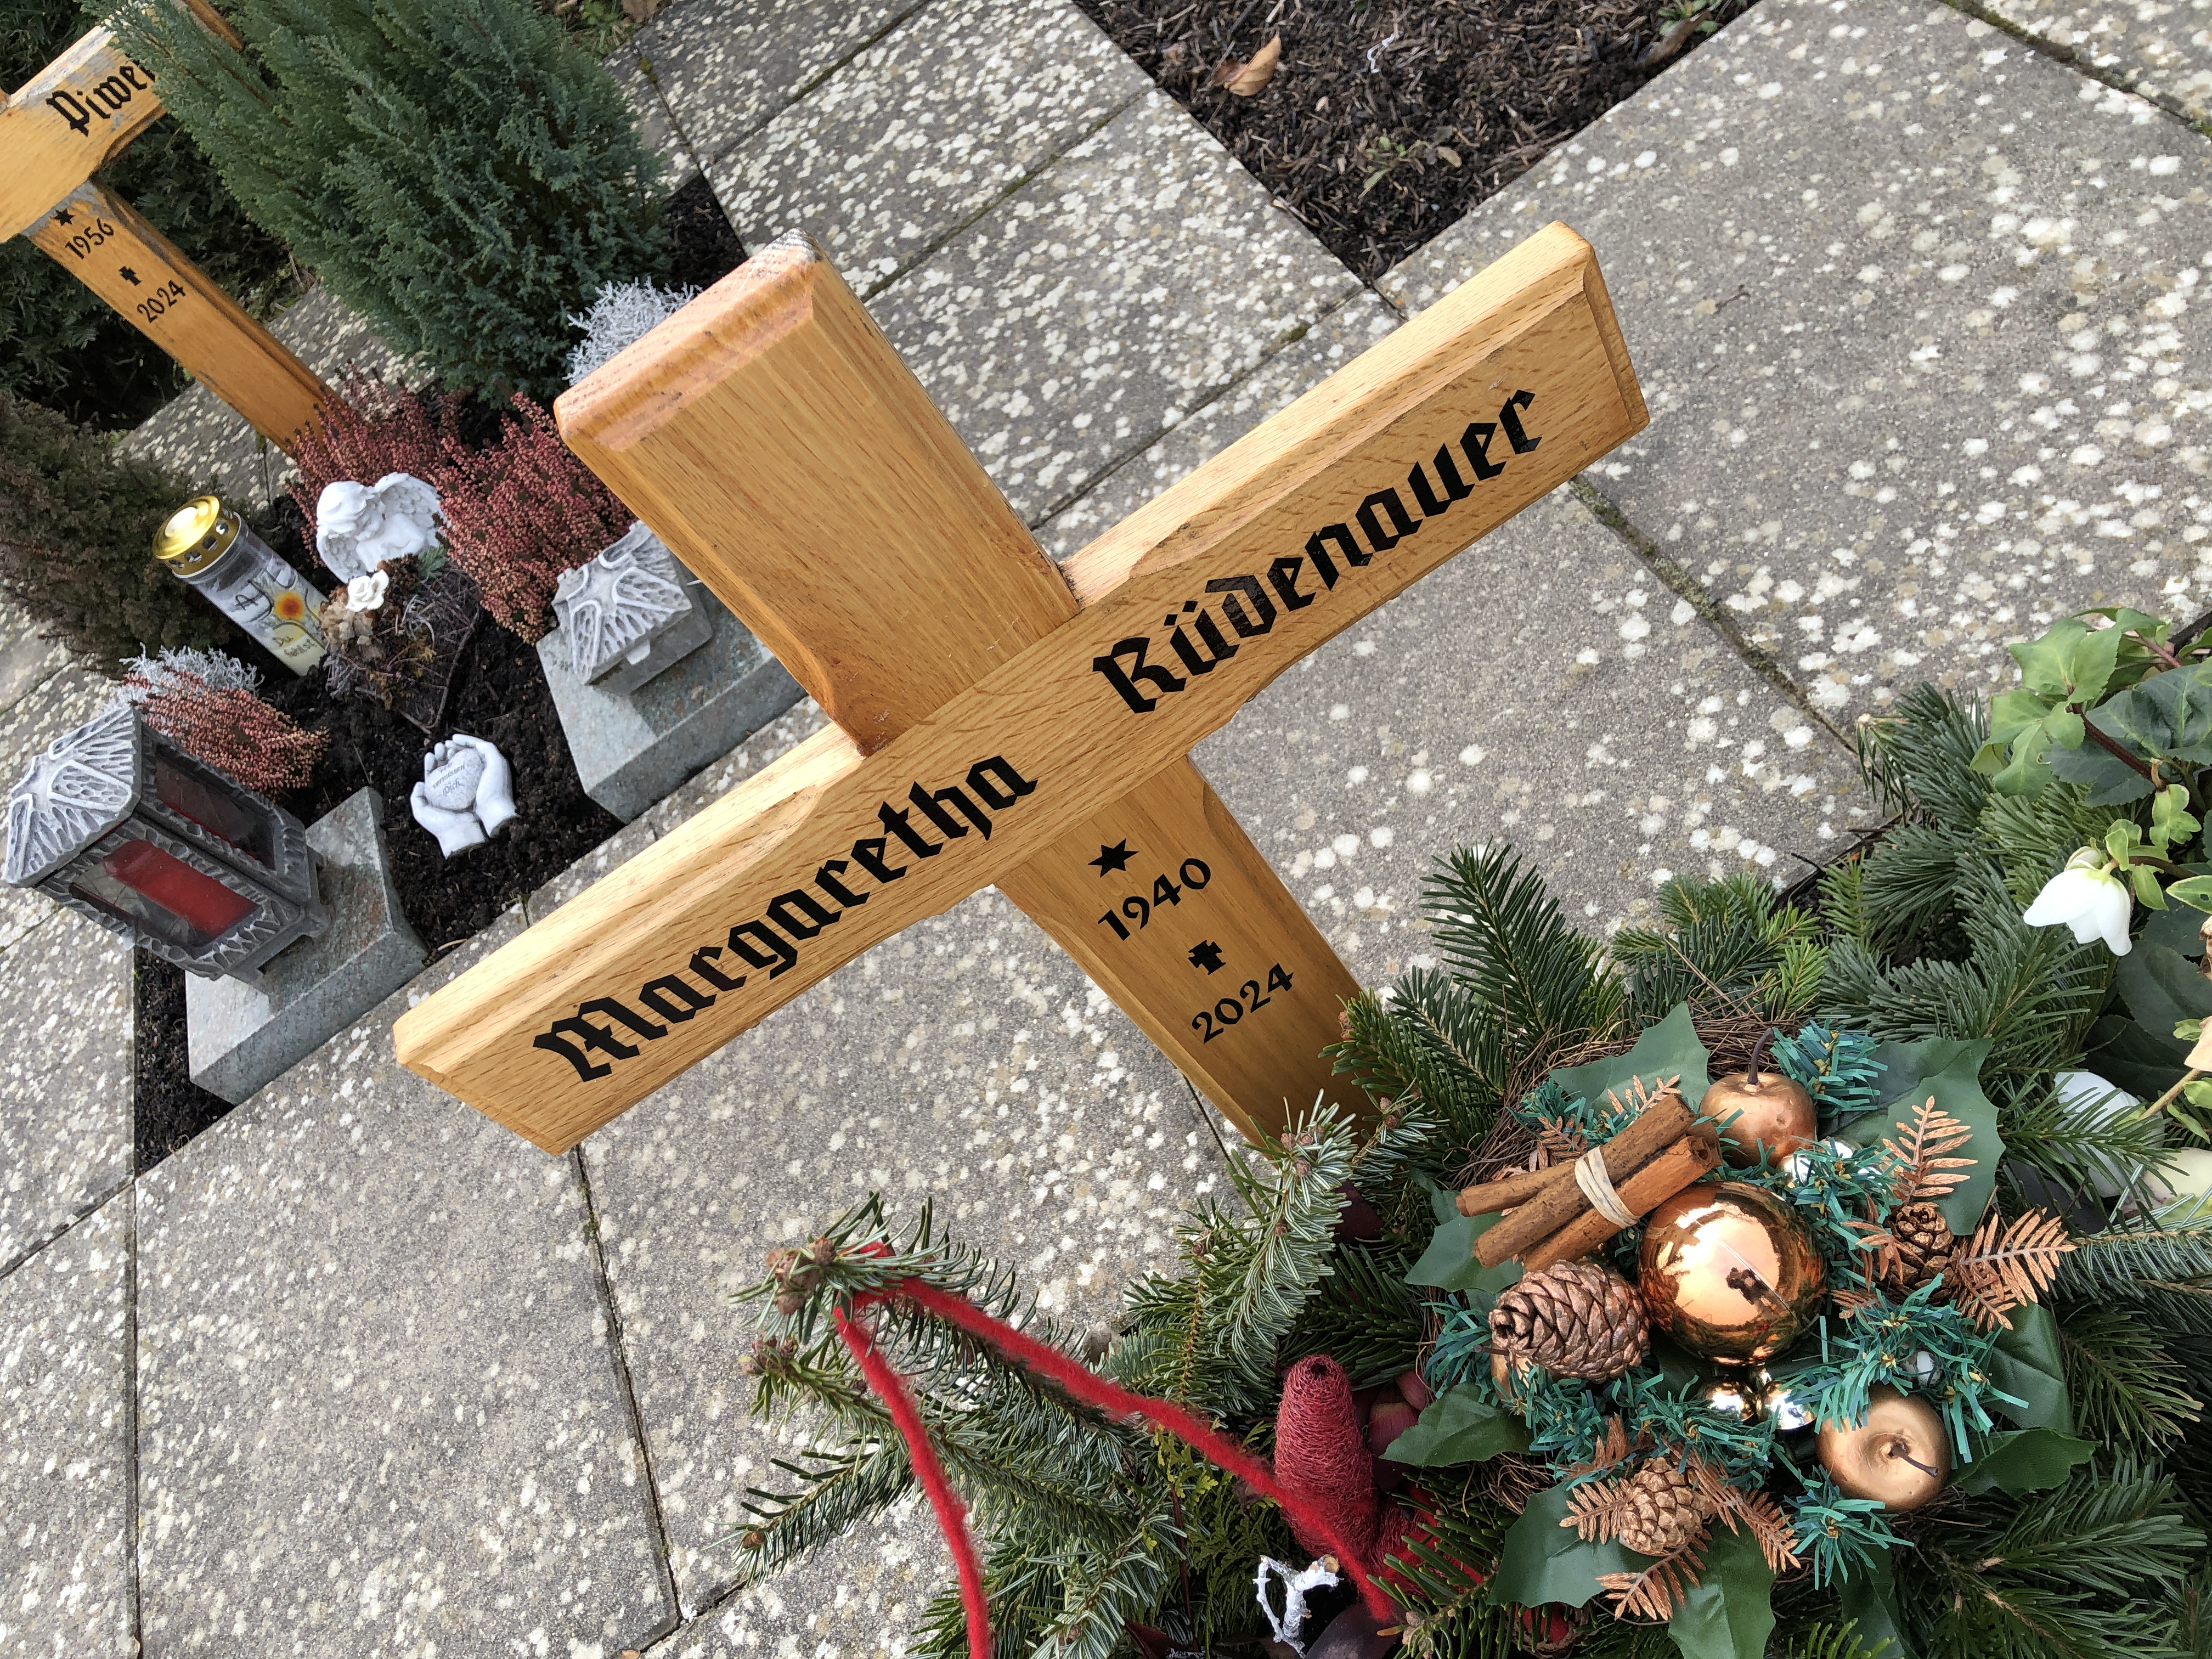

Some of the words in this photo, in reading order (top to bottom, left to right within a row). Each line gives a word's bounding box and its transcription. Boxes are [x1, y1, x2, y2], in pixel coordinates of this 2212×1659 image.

[65, 217, 115, 259] 1956
[137, 280, 186, 323] 2024
[532, 754, 1039, 1083] Margaretha
[1092, 389, 1543, 714] Rüdenauer
[1097, 857, 1212, 941] 1940
[1191, 962, 1294, 1044] 2024
